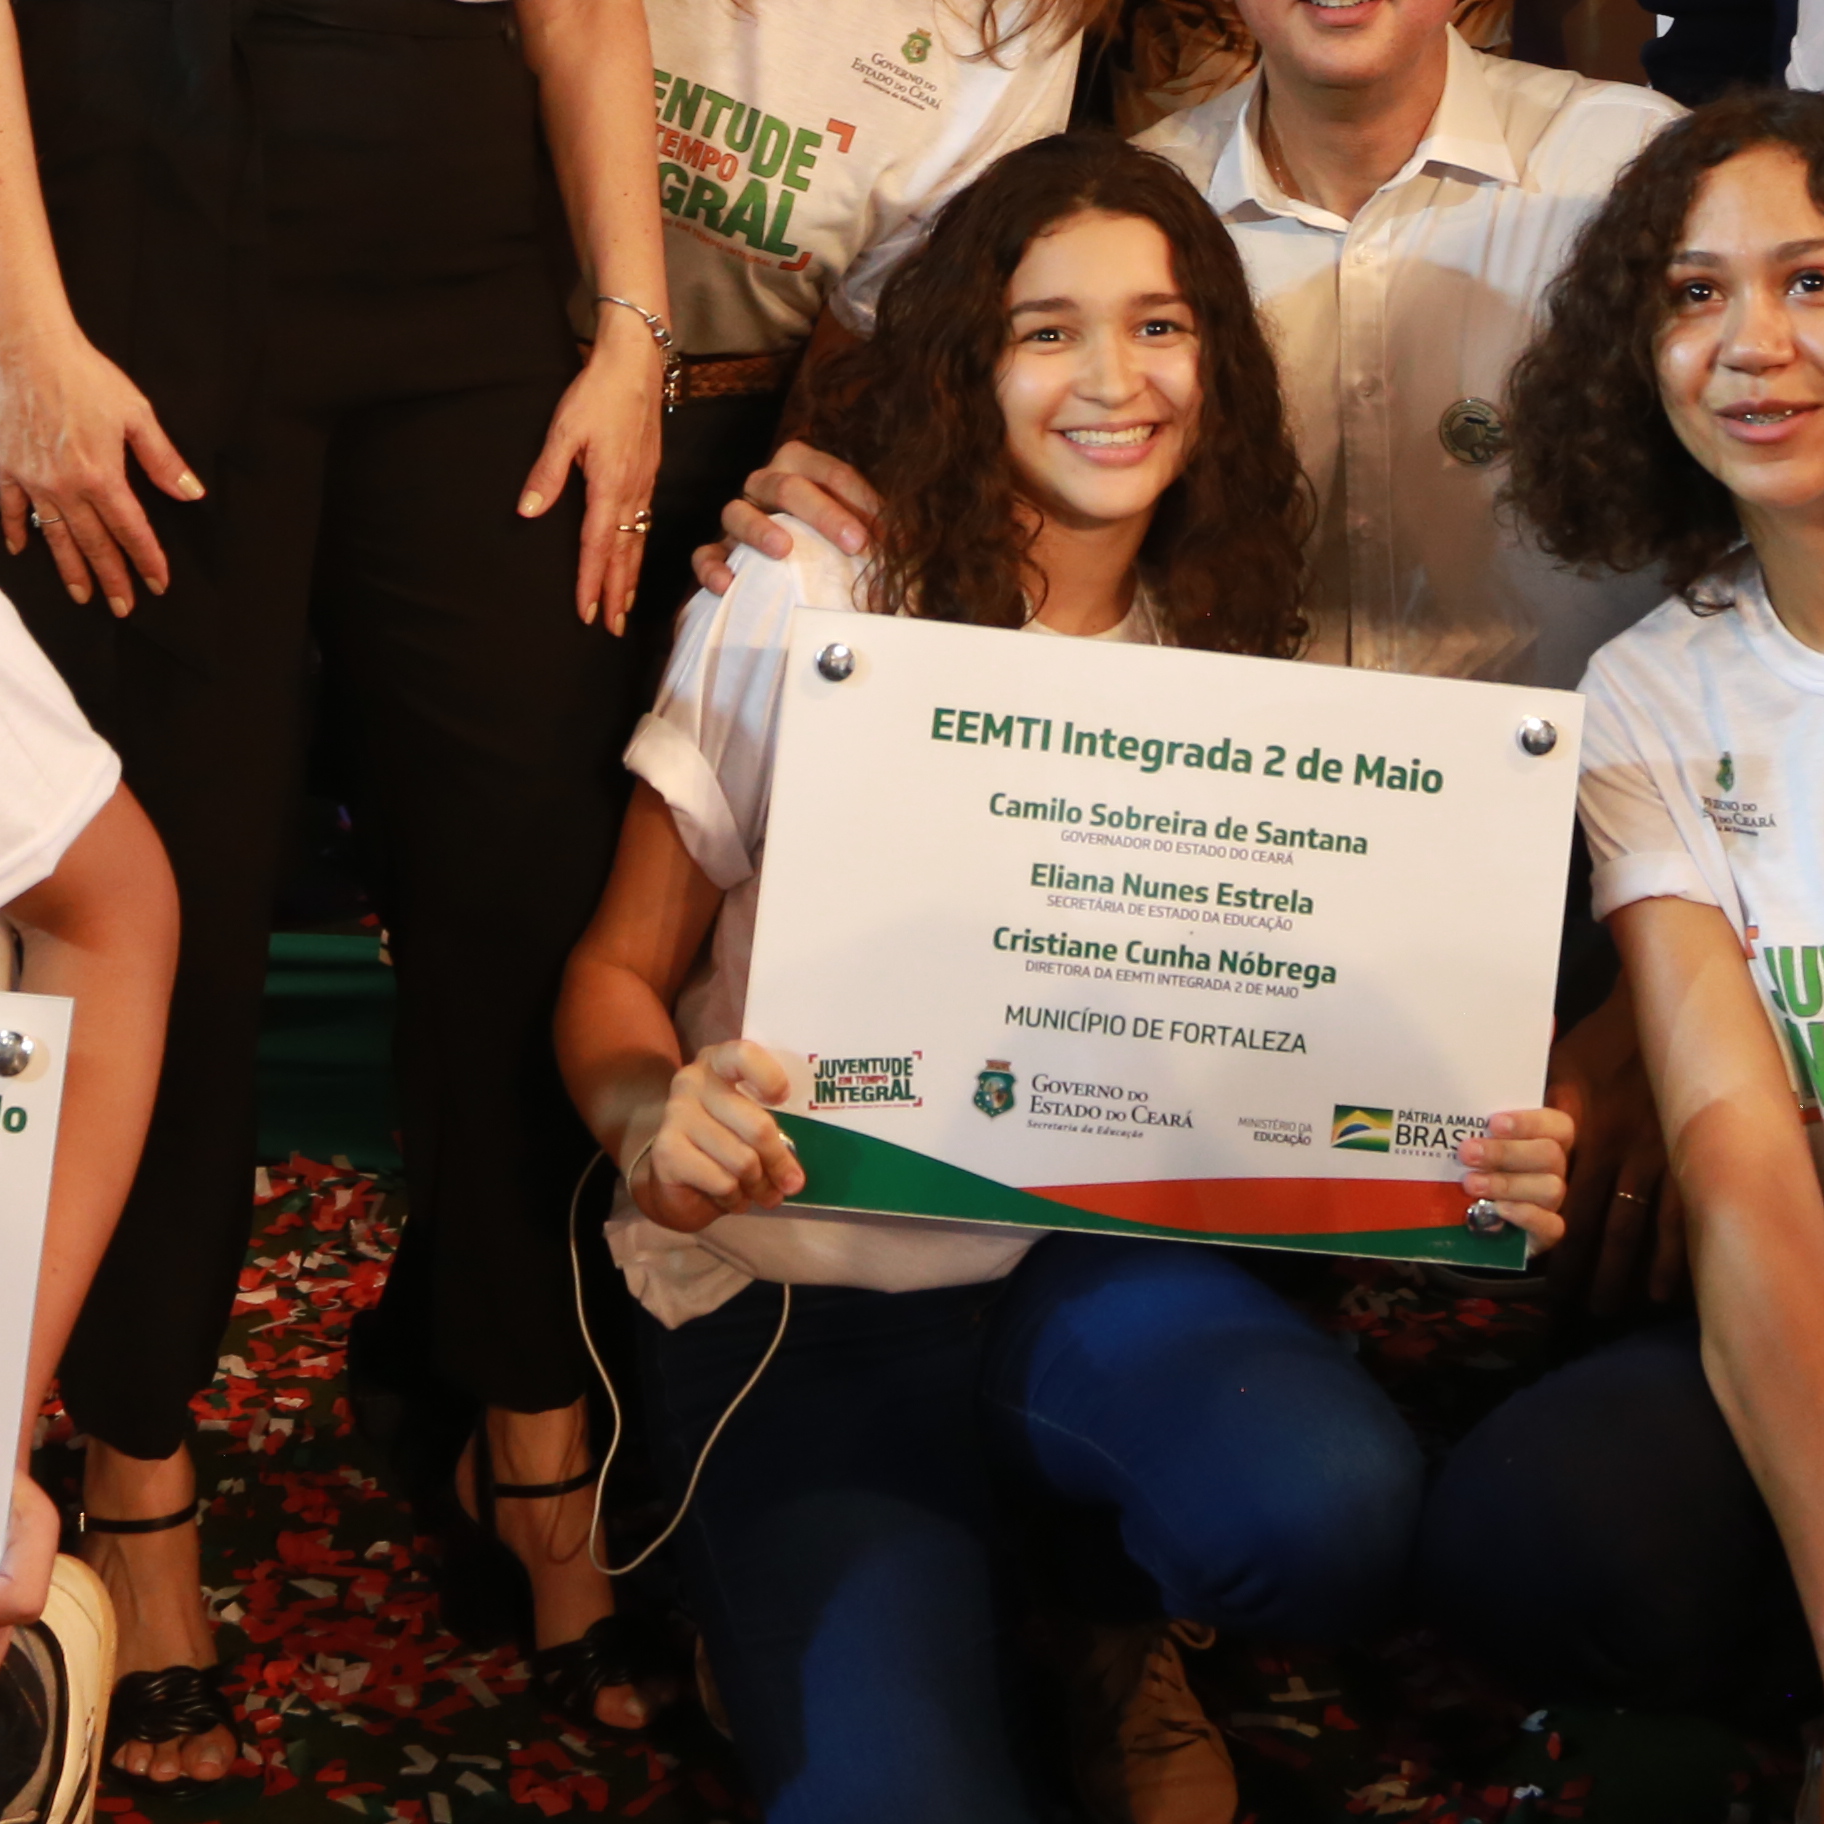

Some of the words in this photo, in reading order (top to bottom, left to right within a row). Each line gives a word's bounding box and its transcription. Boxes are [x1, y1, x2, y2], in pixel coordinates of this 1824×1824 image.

[931, 707, 1052, 751] EEMTI
[1062, 722, 1252, 774] Integrada
[1263, 745, 1286, 777] 2
[1296, 747, 1343, 783] de
[1354, 754, 1443, 794] Maio
[993, 927, 1118, 961] Cristiane
[1126, 940, 1211, 971] Cunha
[1218, 950, 1336, 989] Nóbrega
[1005, 1005, 1126, 1036] MUNICÍPIO
[1132, 1017, 1164, 1040] DE
[1170, 1021, 1306, 1054] FORTALEZA
